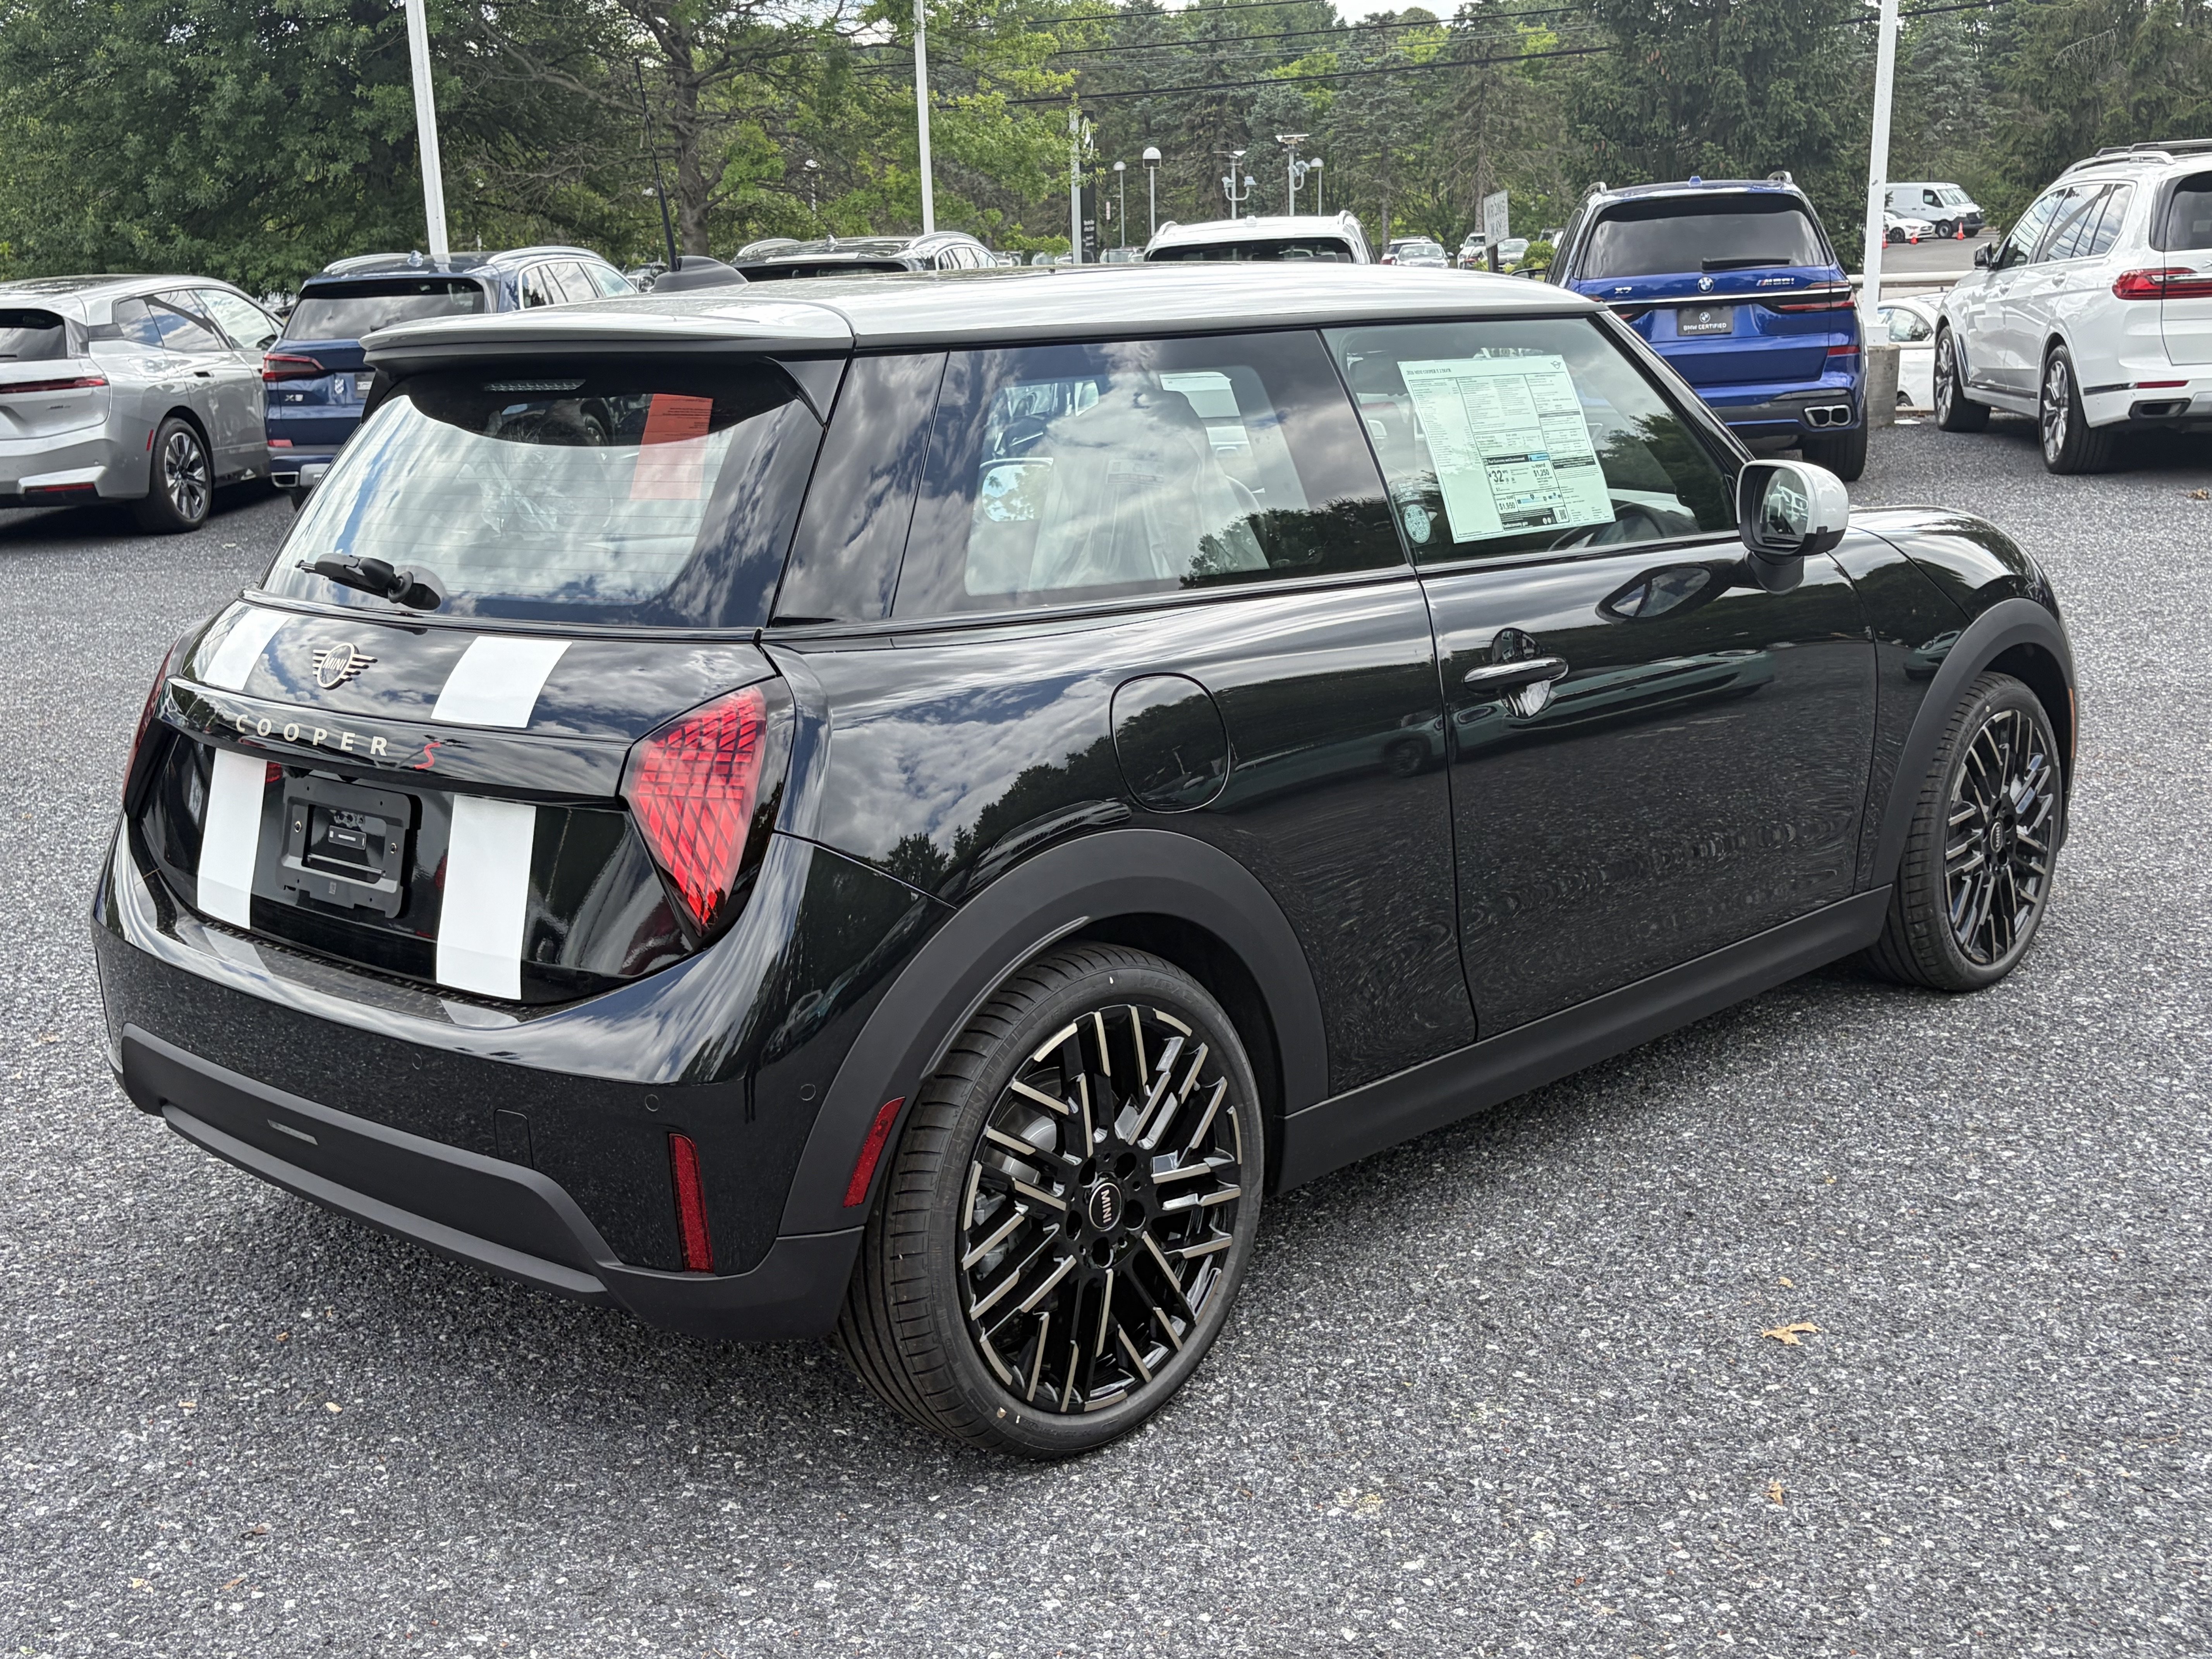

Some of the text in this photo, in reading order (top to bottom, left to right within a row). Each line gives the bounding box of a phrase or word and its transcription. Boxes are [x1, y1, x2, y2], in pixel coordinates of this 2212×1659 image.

[1698, 322, 1727, 330] CERTIFIED
[1492, 470, 1504, 483] 32
[323, 657, 347, 671] MINI
[235, 714, 442, 770] COOPER S
[1101, 1189, 1112, 1224] MINI
